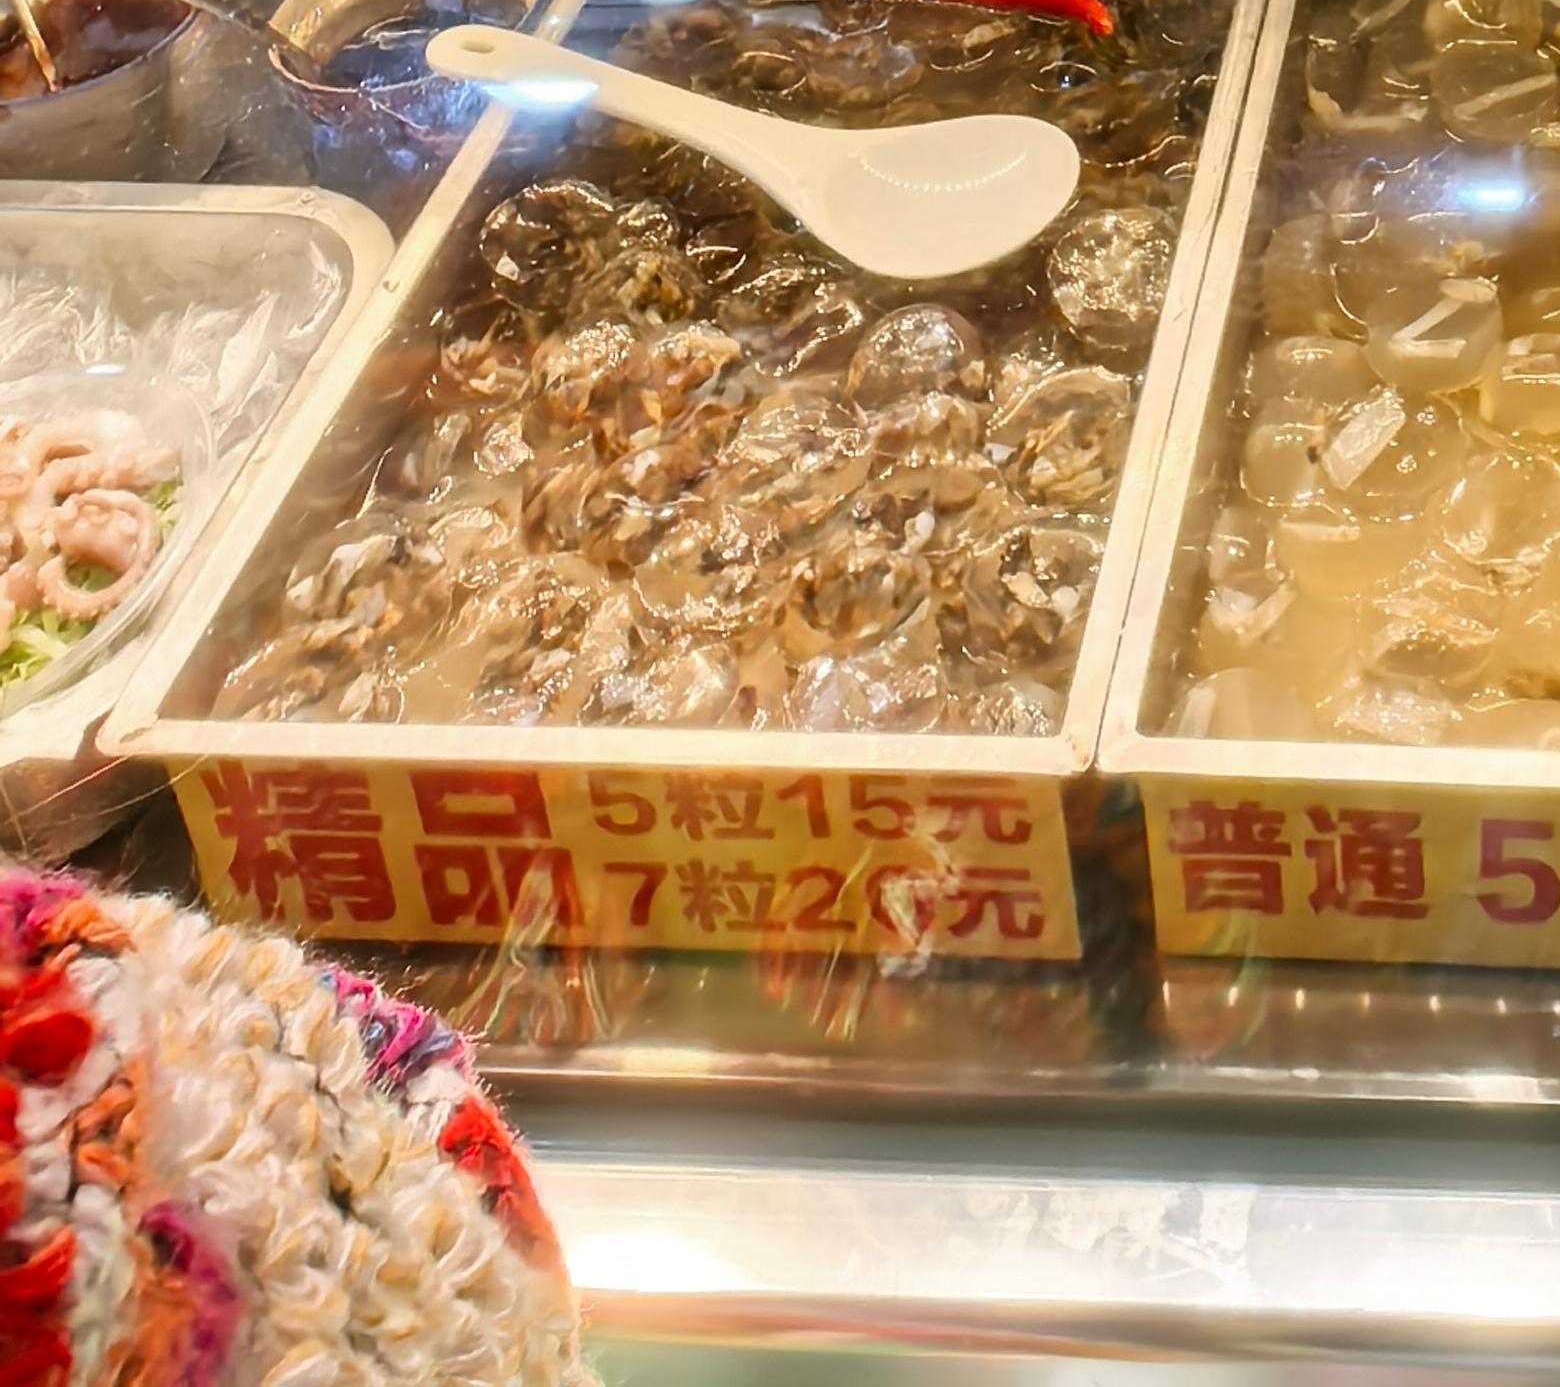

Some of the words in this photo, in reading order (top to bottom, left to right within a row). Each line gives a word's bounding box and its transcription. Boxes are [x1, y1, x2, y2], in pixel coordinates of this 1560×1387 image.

[203, 759, 586, 929] 精品
[588, 772, 1036, 846] 5粒15元
[602, 860, 1047, 938] 7粒20元
[1168, 799, 1432, 921] 普通
